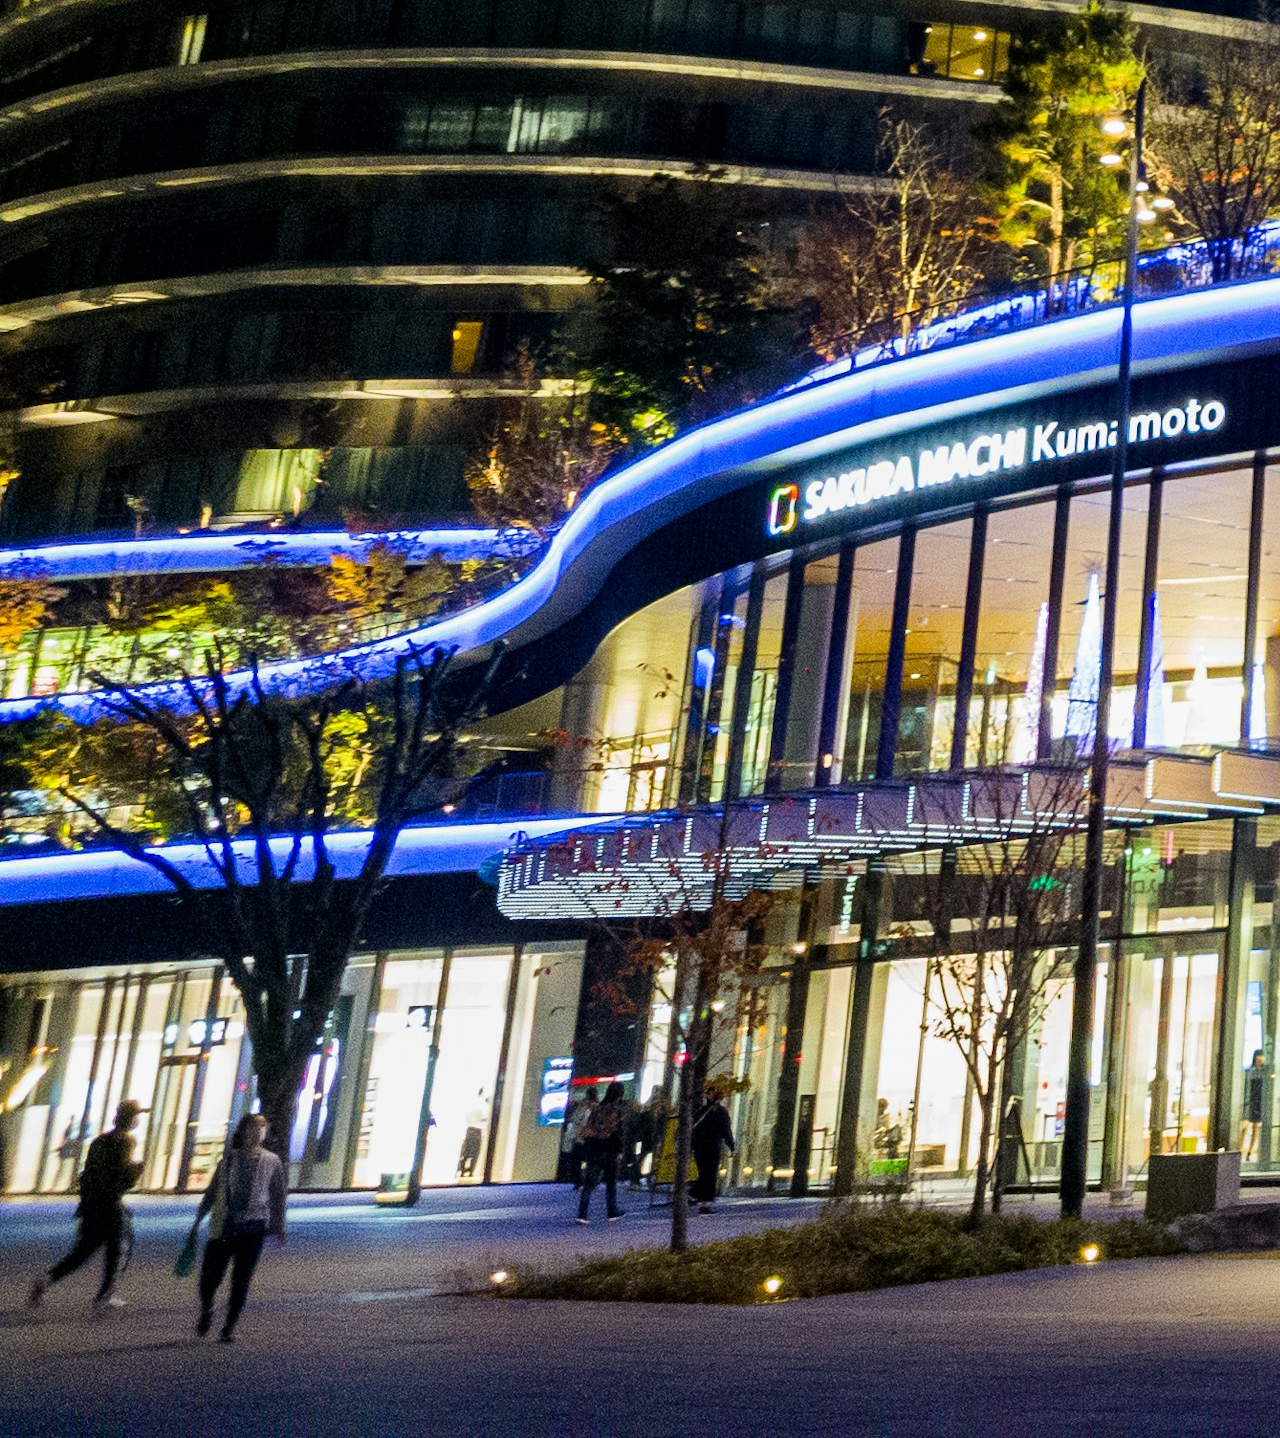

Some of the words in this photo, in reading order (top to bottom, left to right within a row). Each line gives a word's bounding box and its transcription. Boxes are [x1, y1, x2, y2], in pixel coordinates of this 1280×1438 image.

[803, 456, 915, 520] SAKURA
[917, 427, 1027, 489] MACHI
[1032, 399, 1226, 462] Kumamoto
